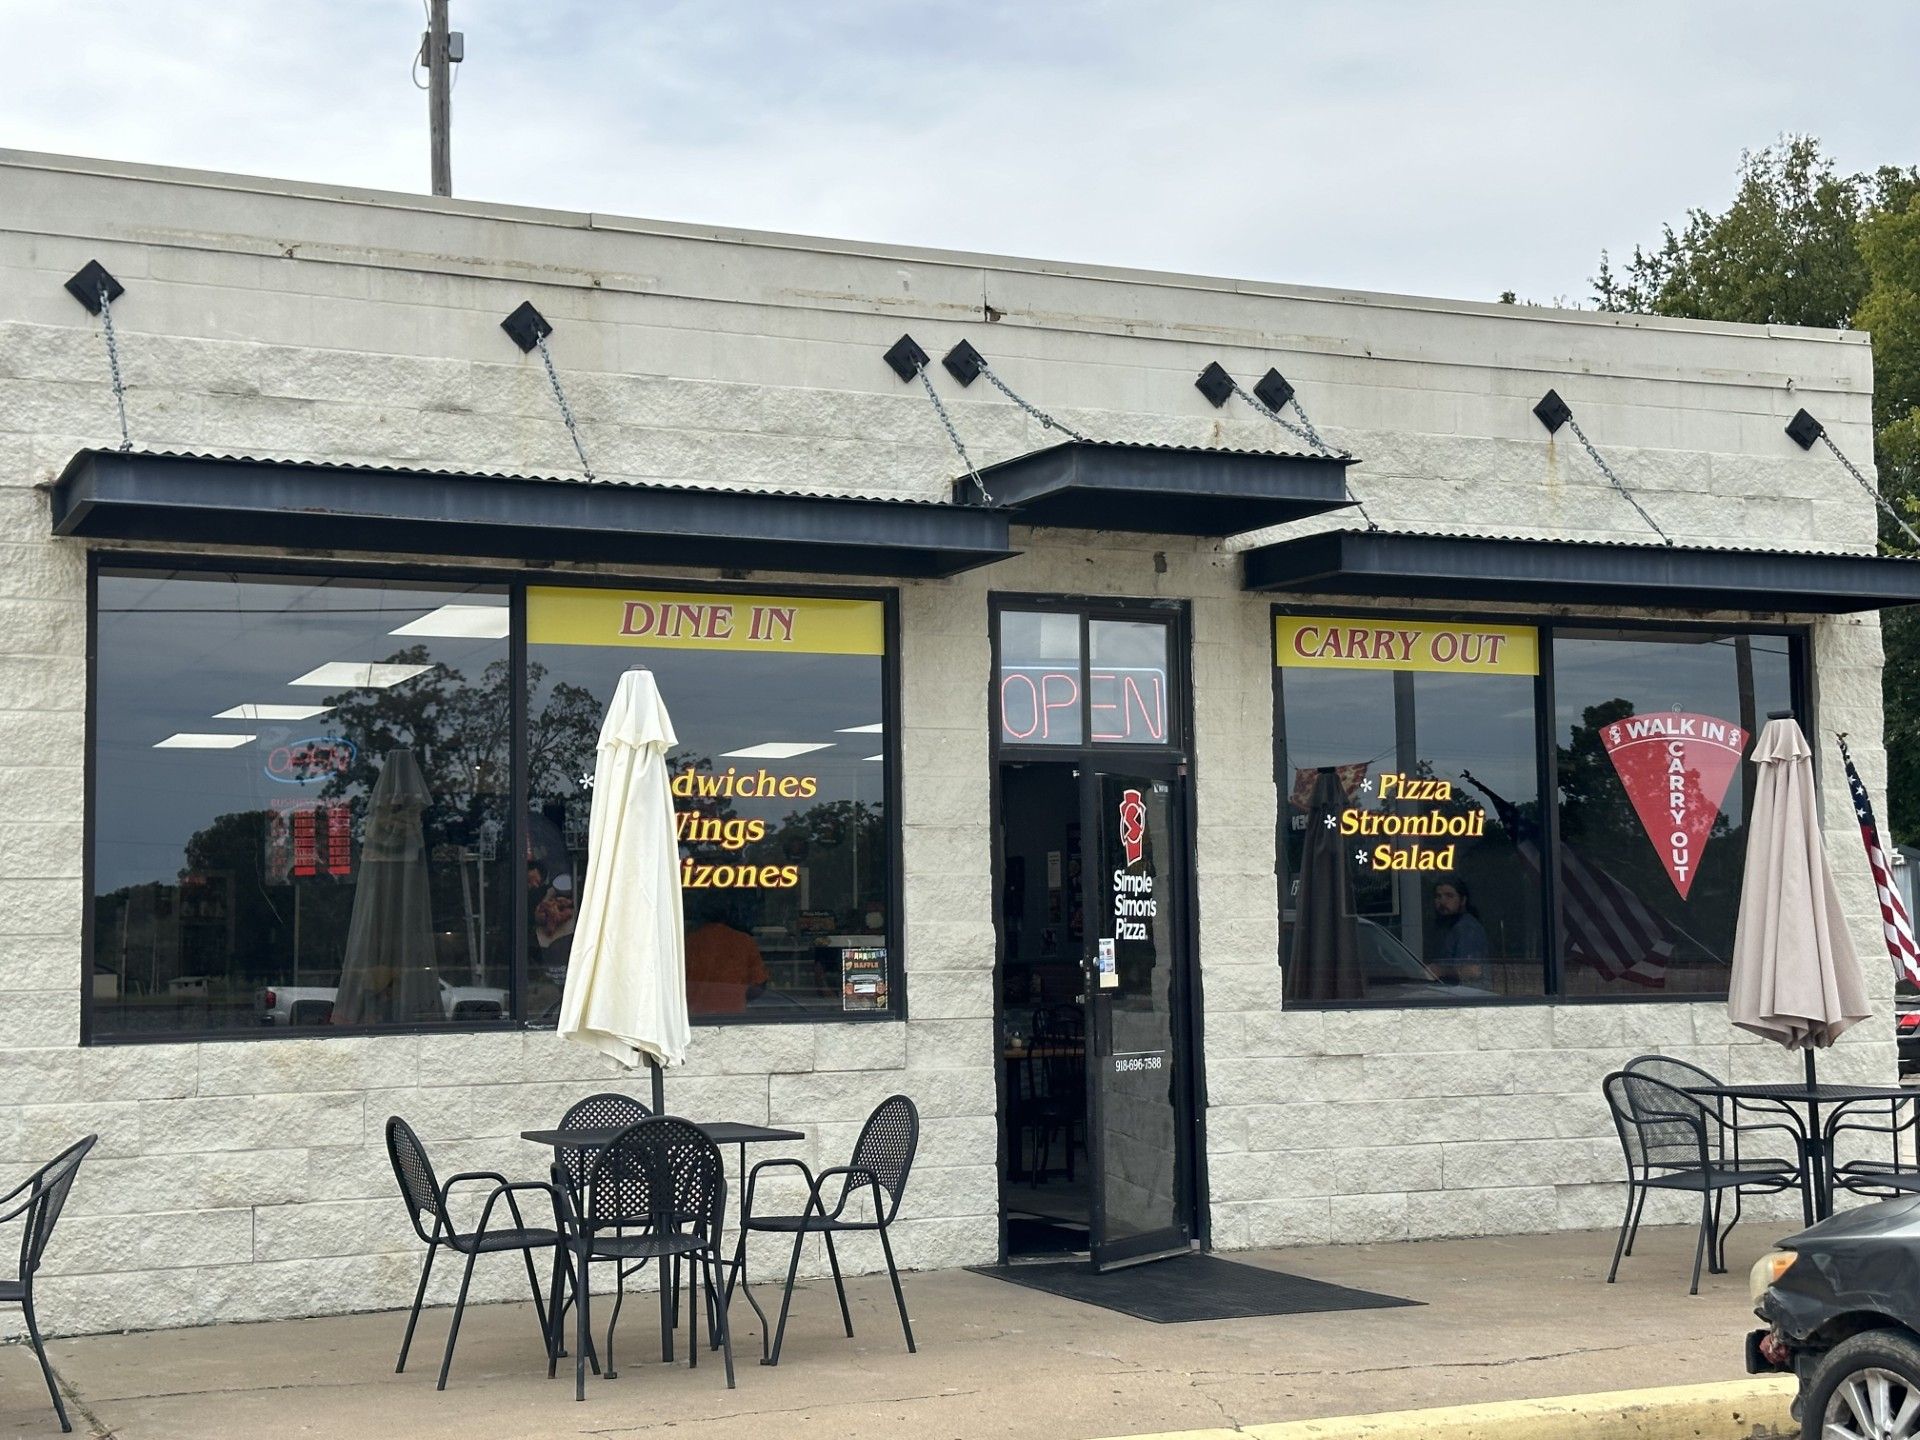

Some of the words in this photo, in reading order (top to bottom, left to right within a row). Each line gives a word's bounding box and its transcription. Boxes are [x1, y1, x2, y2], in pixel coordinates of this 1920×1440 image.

[619, 601, 736, 640] DINE
[748, 606, 797, 642] IN
[1293, 625, 1423, 661] CARRY
[1430, 631, 1506, 664] OUT
[1001, 674, 1161, 739] OPEN
[1625, 718, 1697, 739] WALK
[1701, 721, 1725, 742] IN
[269, 747, 350, 773] OPEN
[671, 767, 817, 798] dwiches
[1377, 773, 1452, 801] Pizza
[1667, 741, 1686, 825] CARRY
[1340, 808, 1485, 837] Stromboli
[1372, 844, 1456, 871] Salad
[1670, 831, 1690, 882] OUT
[679, 857, 798, 888] izones
[1113, 869, 1153, 897] Simple
[1114, 894, 1157, 917] Simon's
[1115, 917, 1148, 940] Pizza
[1115, 1056, 1162, 1072] 918-696-7588
